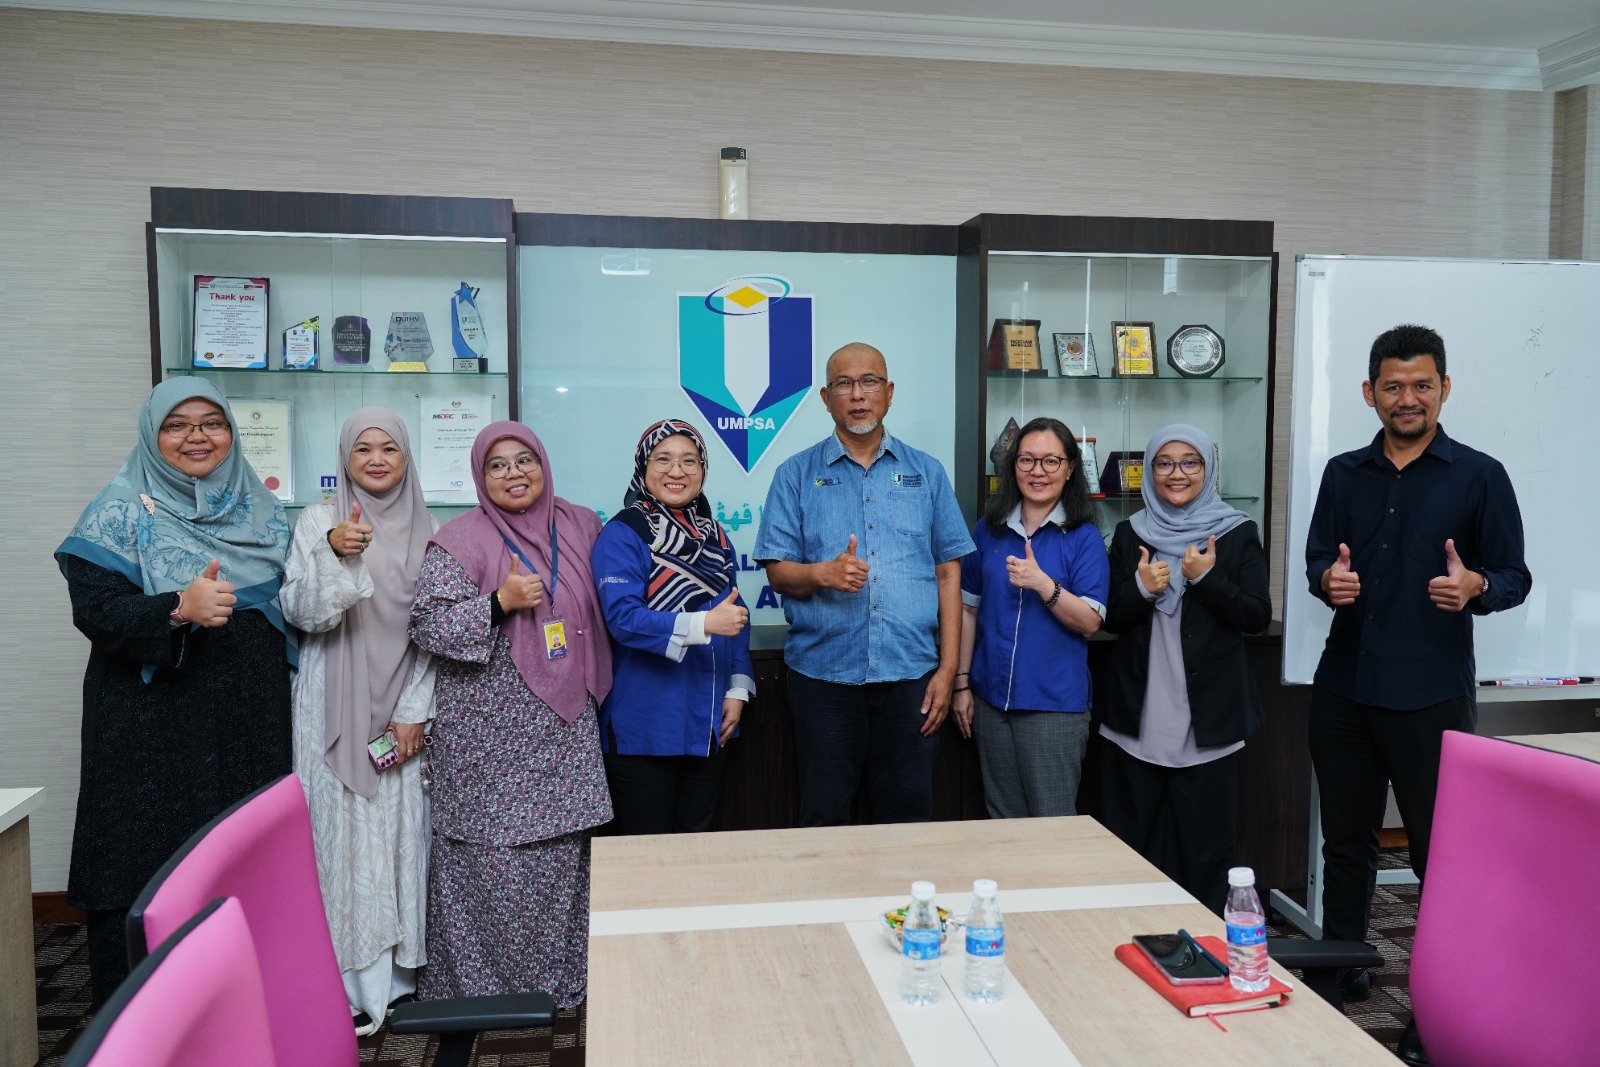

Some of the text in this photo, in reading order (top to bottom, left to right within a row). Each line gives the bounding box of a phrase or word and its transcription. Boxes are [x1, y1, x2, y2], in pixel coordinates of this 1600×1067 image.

[209, 292, 255, 303] Thank you
[717, 417, 776, 430] UMPSA
